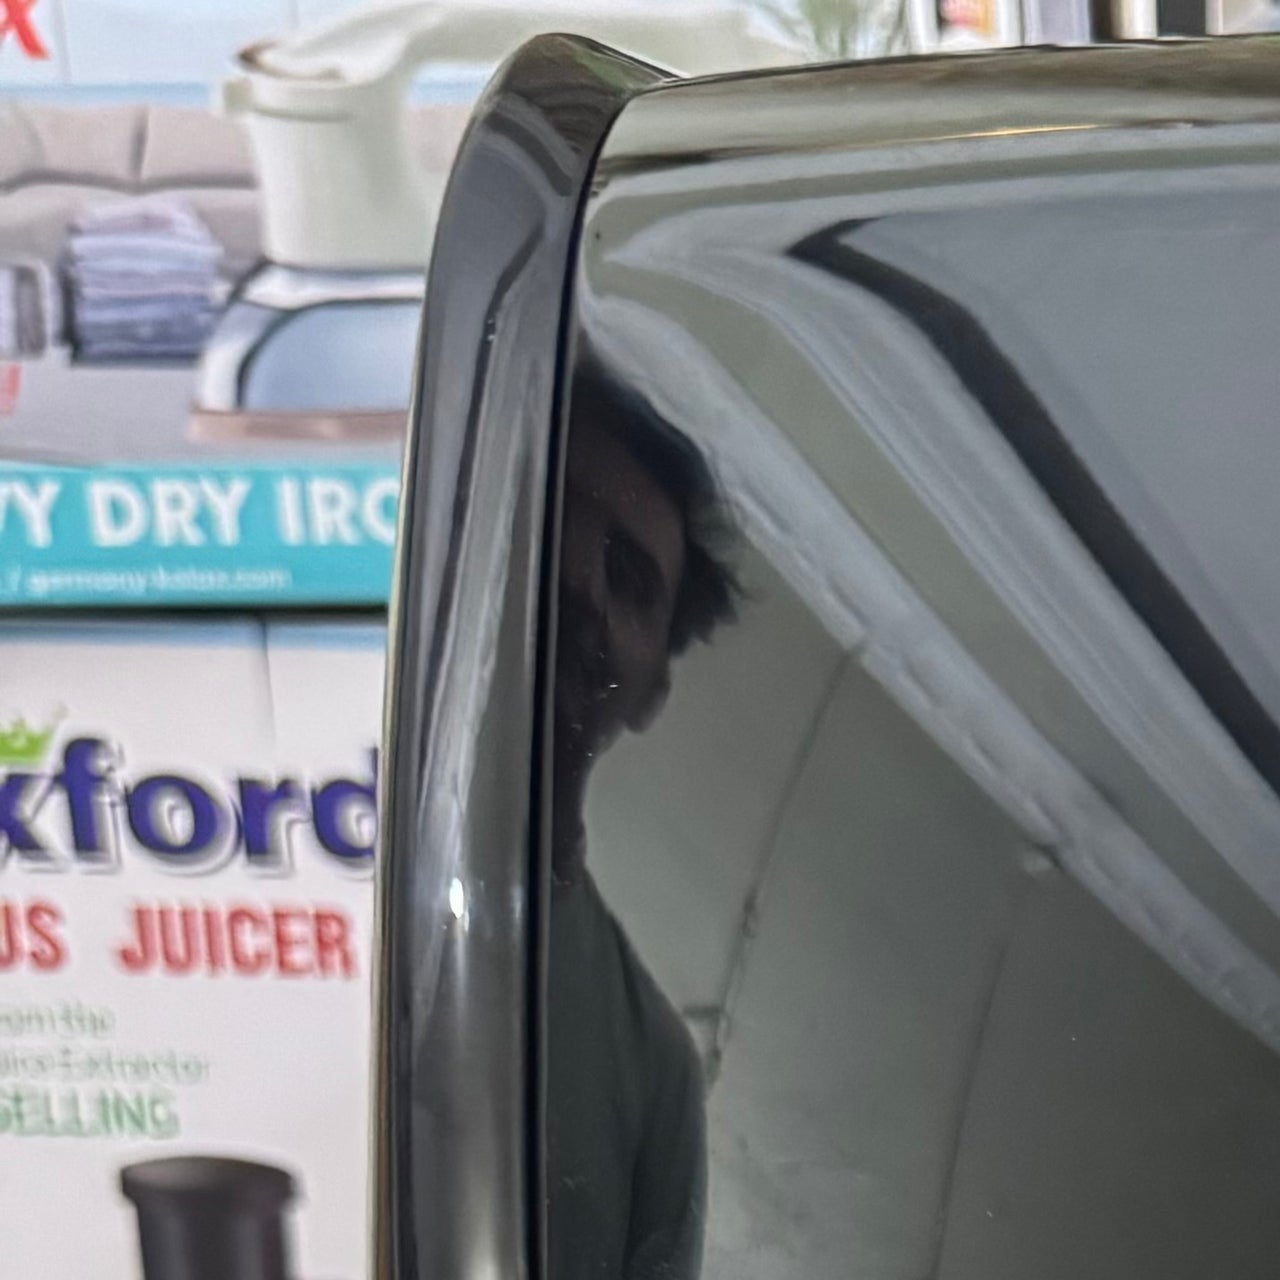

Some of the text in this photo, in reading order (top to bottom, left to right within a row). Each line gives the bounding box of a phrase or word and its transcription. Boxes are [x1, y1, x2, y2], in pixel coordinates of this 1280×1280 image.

[0, 478, 60, 547] Y
[87, 478, 252, 547] DRY
[117, 902, 358, 978] JUICER
